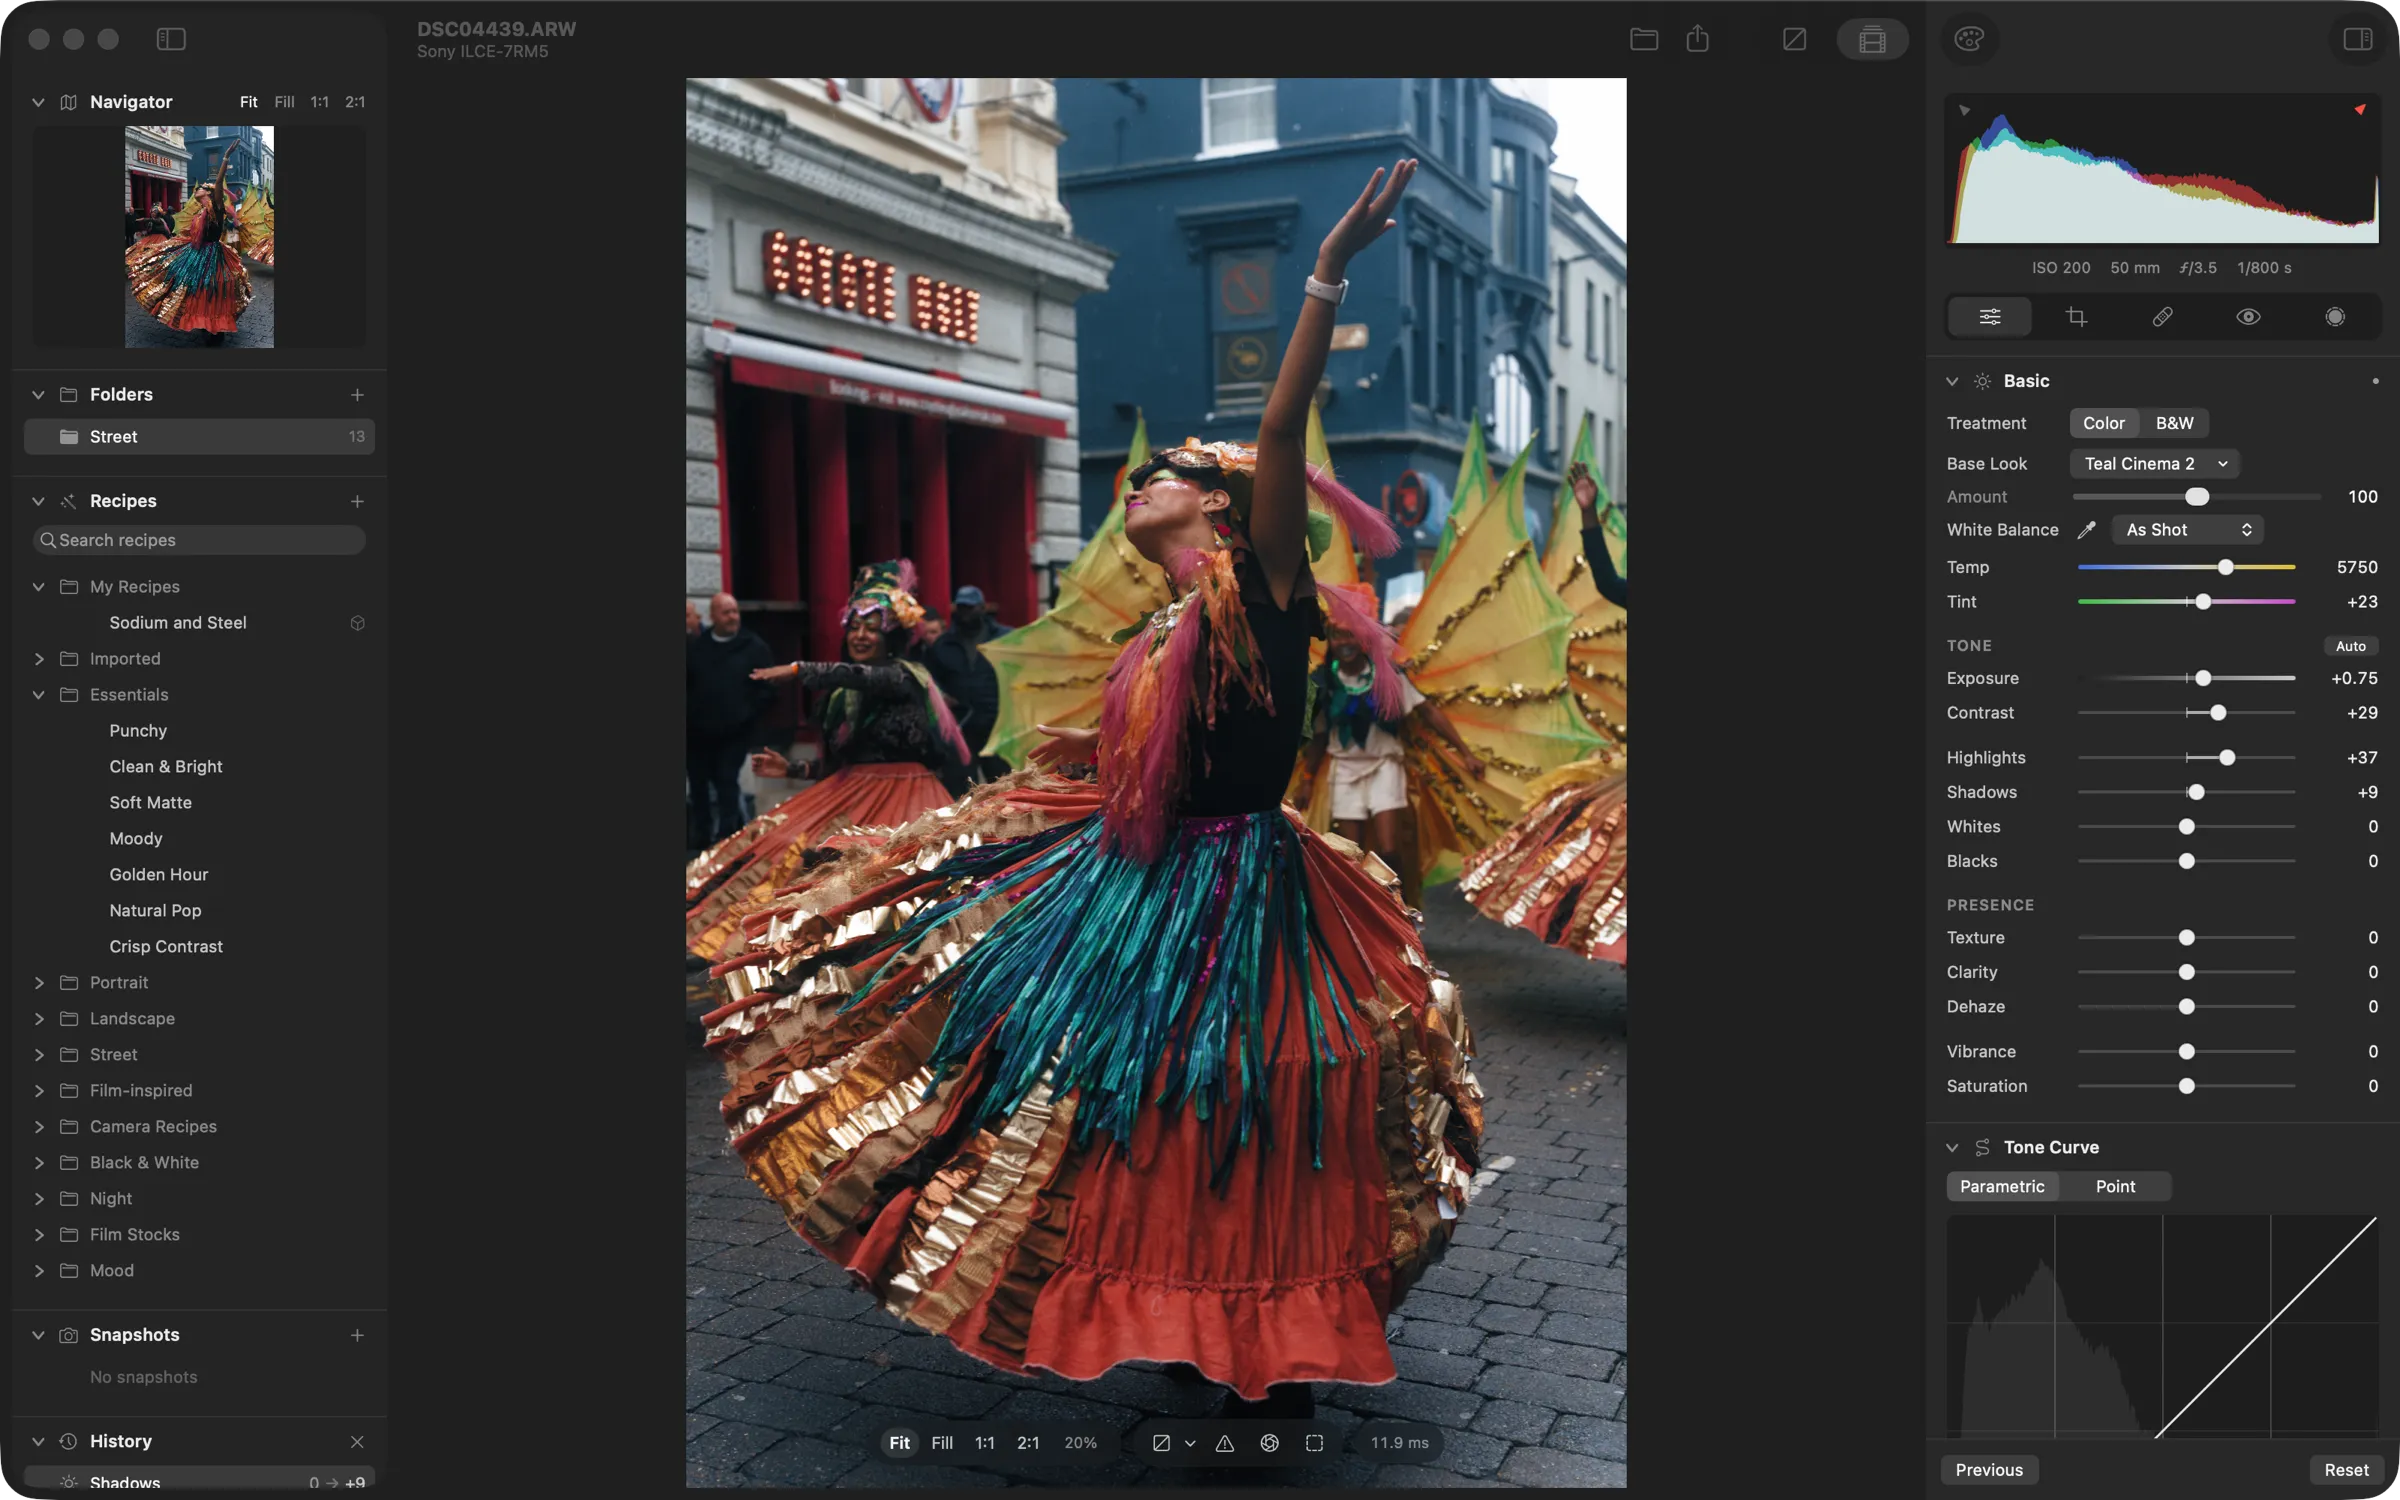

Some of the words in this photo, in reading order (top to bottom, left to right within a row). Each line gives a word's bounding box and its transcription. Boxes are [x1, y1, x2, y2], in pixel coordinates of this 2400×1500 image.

[417, 20, 577, 38] DSC04439.ARW
[417, 44, 456, 61] Sony
[461, 44, 549, 58] ILCE-7RM5
[90, 93, 174, 113] Navigator
[240, 95, 259, 109] Fit
[274, 95, 295, 109] Fill
[310, 95, 329, 108] 1:1
[345, 95, 365, 109] 2:1
[2032, 261, 2058, 274] ISO
[2063, 261, 2091, 274] 200
[2110, 261, 2130, 274] 50
[2134, 263, 2161, 274] mm
[2237, 260, 2280, 277] 1/800
[2284, 263, 2292, 274] s
[2004, 372, 2050, 388] Basic
[90, 386, 154, 402] Folders
[1946, 416, 2027, 430] Treatment
[2083, 415, 2126, 430] Color
[2156, 416, 2195, 430] B&W
[90, 429, 138, 444] Street
[348, 429, 366, 443] 13
[1947, 456, 1986, 471] Base
[1990, 456, 2028, 471] Look
[2084, 456, 2117, 471] Teal
[2121, 456, 2181, 471] Cinema
[2185, 456, 2195, 471] 2
[90, 492, 157, 511] Recipes
[1946, 489, 2008, 504] Amount
[2348, 489, 2379, 504] 100
[1946, 522, 1993, 537] White
[1997, 522, 2060, 537] Balance
[2126, 522, 2147, 537] As
[2151, 522, 2188, 537] Shot
[59, 532, 114, 547] Search
[118, 532, 176, 550] recipes
[1946, 560, 1990, 577] Temp
[2337, 559, 2379, 574] 5750
[90, 579, 114, 597] My
[118, 579, 181, 597] Recipes
[1946, 594, 1977, 609] Tint
[2347, 594, 2379, 609] +23
[109, 615, 168, 630] Sodium
[173, 615, 202, 630] and
[207, 615, 247, 630] Steel
[1946, 639, 1992, 652] TONE
[2335, 640, 2367, 652] Auto
[90, 651, 161, 669] Imported
[1947, 671, 2020, 688] Exposure
[2331, 671, 2379, 685] +0.75
[90, 687, 169, 702] Essentials
[1947, 705, 2015, 720] Contrast
[2347, 705, 2379, 720] +29
[110, 723, 168, 741] Punchy
[1947, 750, 2027, 768] Highlights
[2347, 750, 2379, 765] +37
[109, 759, 154, 774] Clean
[158, 759, 171, 774] &
[175, 759, 223, 777] Bright
[1947, 784, 2018, 799] Shadows
[2357, 785, 2379, 799] +9
[109, 795, 142, 810] Soft
[147, 795, 193, 810] Matte
[1946, 819, 2001, 834] Whites
[2368, 819, 2379, 834] 0
[110, 831, 163, 849] Moody
[1947, 853, 1998, 868] Blacks
[2368, 853, 2379, 868] 0
[109, 867, 166, 882] Golden
[170, 867, 210, 882] Hour
[110, 903, 167, 918] Natural
[172, 903, 202, 921] Pop
[1947, 898, 2035, 912] PRESENCE
[1946, 930, 2006, 945] Texture
[2368, 930, 2379, 945] 0
[109, 939, 151, 957] Crisp
[155, 939, 224, 954] Contrast
[1947, 964, 1999, 982] Clarity
[2368, 964, 2379, 979] 0
[90, 975, 149, 990] Portrait
[1947, 999, 2006, 1014] Dehaze
[2368, 999, 2379, 1014] 0
[90, 1011, 176, 1029] Landscape
[90, 1047, 138, 1062] Street
[1946, 1044, 2017, 1059] Vibrance
[2368, 1044, 2379, 1059] 0
[90, 1083, 193, 1100] Film-inspired
[1947, 1078, 2028, 1093] Saturation
[2368, 1078, 2379, 1093] 0
[90, 1119, 151, 1134] Camera
[155, 1119, 218, 1136] Recipes
[2003, 1140, 2045, 1155] Tone
[2049, 1139, 2100, 1155] Curve
[90, 1155, 133, 1170] Black
[137, 1155, 150, 1170] &
[153, 1155, 200, 1170] White
[1960, 1179, 2045, 1194] Parametric
[2096, 1179, 2137, 1194] Point
[90, 1191, 133, 1209] Night
[90, 1227, 122, 1242] Film
[127, 1227, 180, 1242] Stocks
[90, 1263, 134, 1278] Mood
[90, 1326, 180, 1345] Snapshots
[90, 1370, 112, 1384] No
[117, 1369, 198, 1387] snapshots
[90, 1433, 153, 1452] History
[889, 1435, 911, 1450] Fit
[932, 1435, 953, 1450] Fill
[975, 1436, 994, 1450] 1:1
[1017, 1435, 1039, 1450] 2:1
[1064, 1436, 1098, 1449] 20%
[1371, 1436, 1404, 1449] 11.9
[1408, 1438, 1430, 1449] ms
[1956, 1462, 2024, 1477] Previous
[2325, 1463, 2370, 1477] Reset
[90, 1476, 161, 1489] Shadows
[309, 1476, 320, 1489] 0
[345, 1476, 366, 1489] +9
